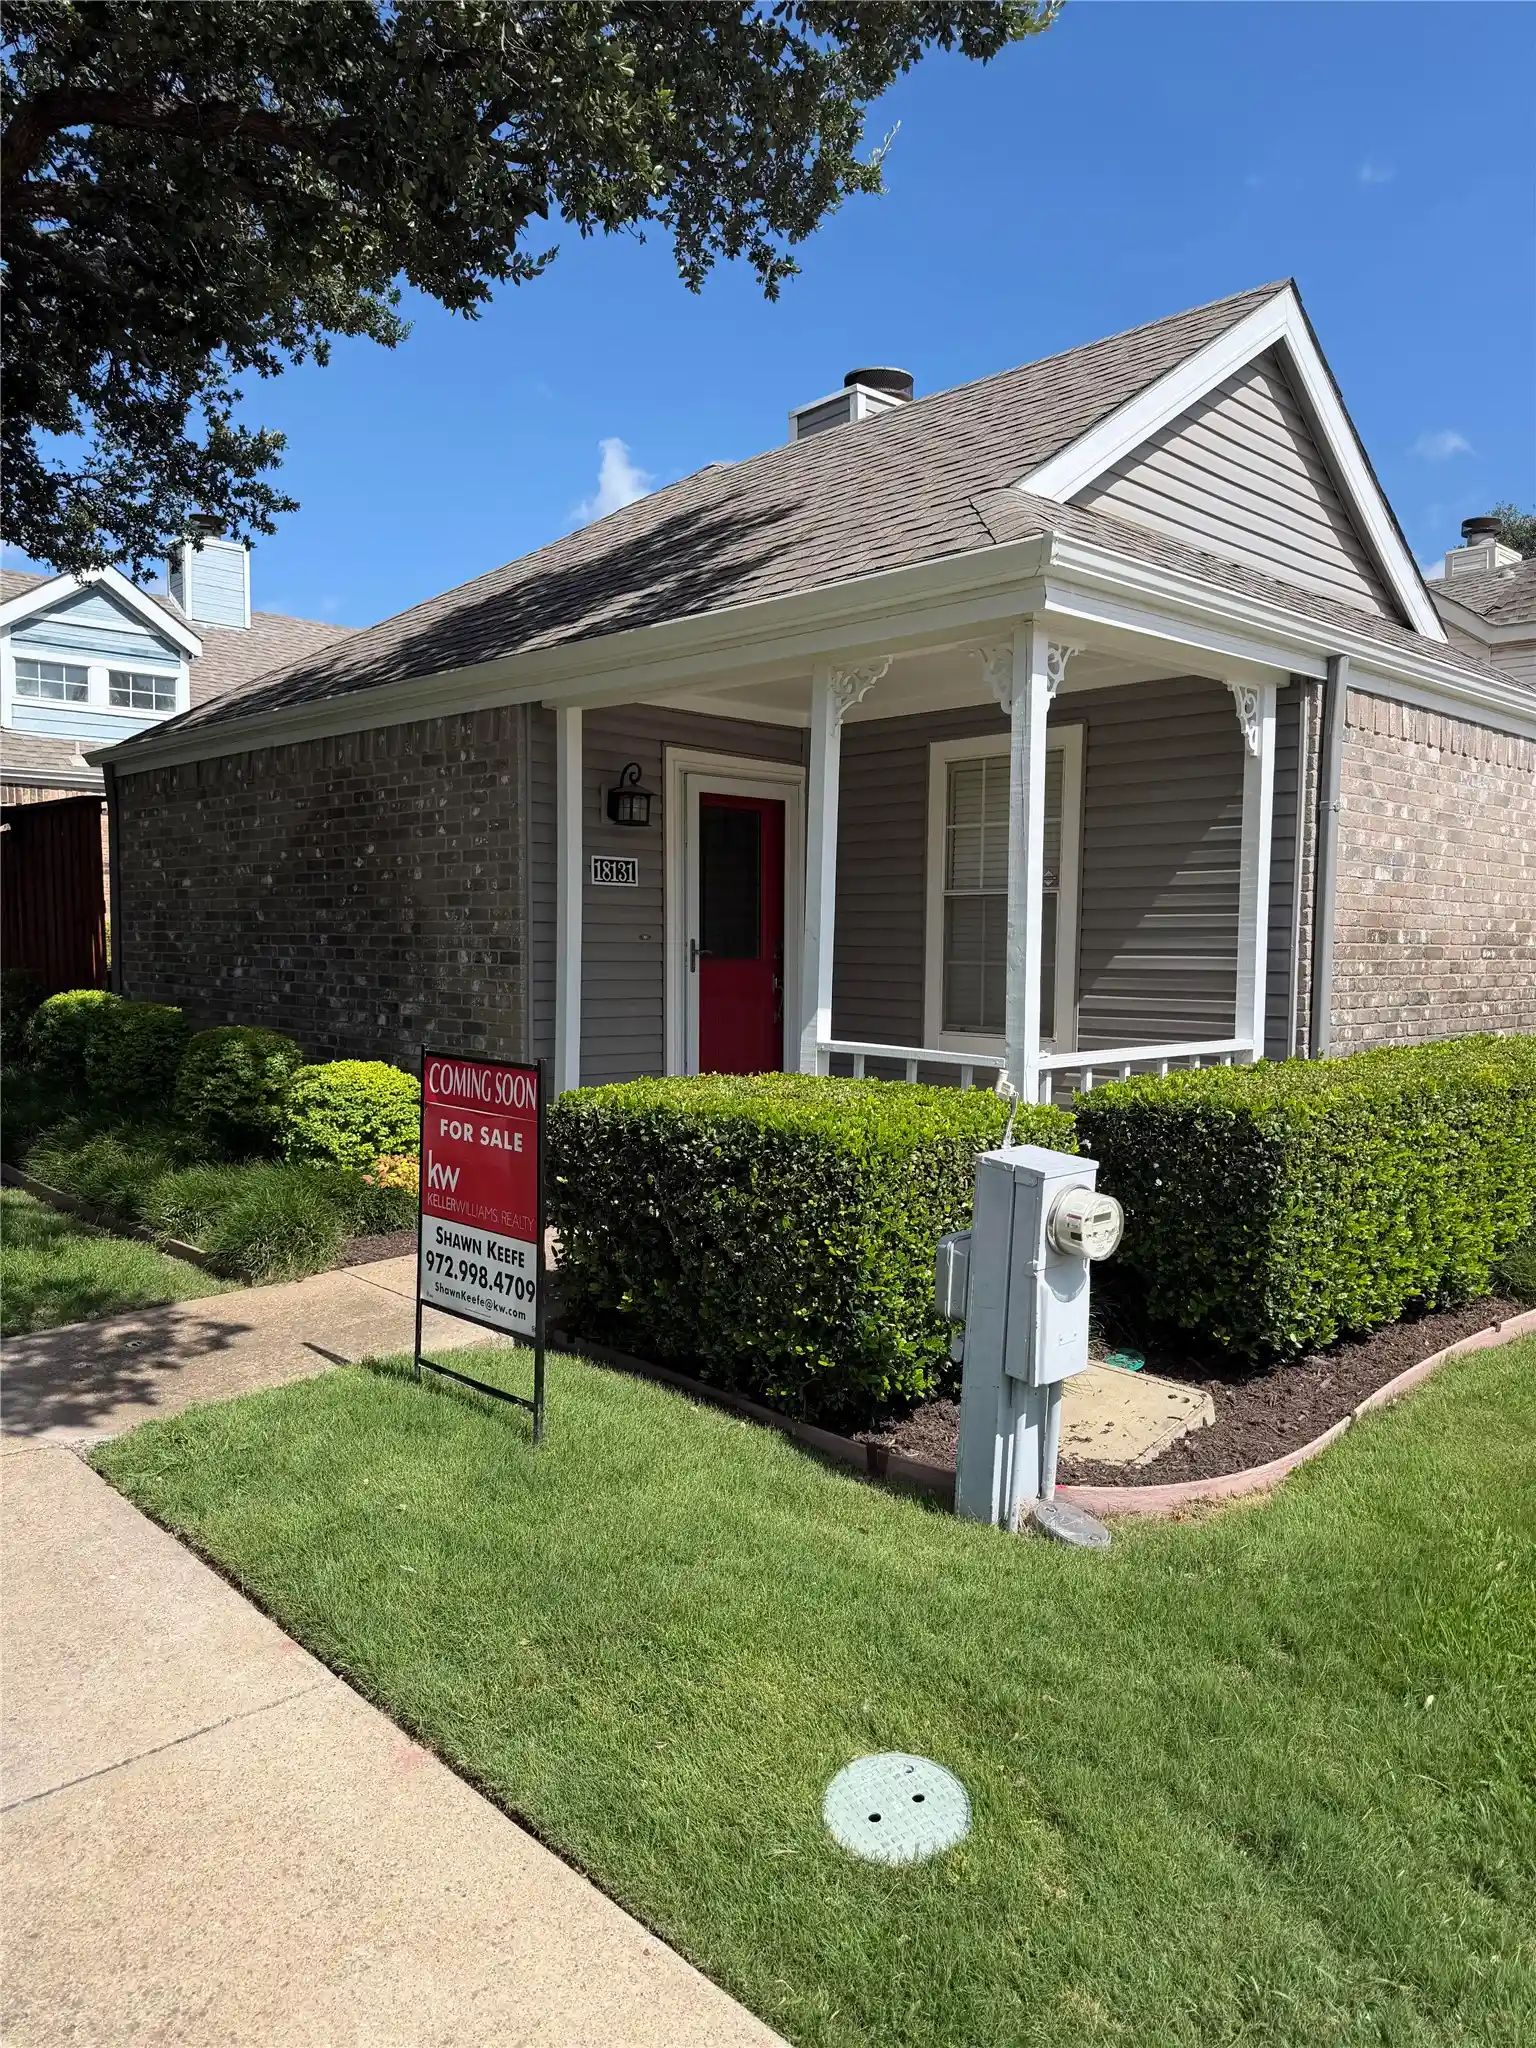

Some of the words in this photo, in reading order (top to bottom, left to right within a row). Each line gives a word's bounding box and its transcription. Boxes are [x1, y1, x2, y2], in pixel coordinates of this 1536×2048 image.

[595, 860, 635, 882] 18131
[429, 1063, 491, 1101] COMING
[495, 1072, 536, 1109] SOON
[440, 1118, 473, 1142] FOR
[480, 1126, 522, 1152] SALE
[428, 1150, 460, 1192] kw
[501, 1210, 534, 1231] REALTY
[436, 1226, 482, 1256] SHAWN
[487, 1240, 525, 1269] KEEFE
[426, 1250, 536, 1303] 972.998.4709
[435, 1281, 527, 1321] ShawnKeefe@kw.com
